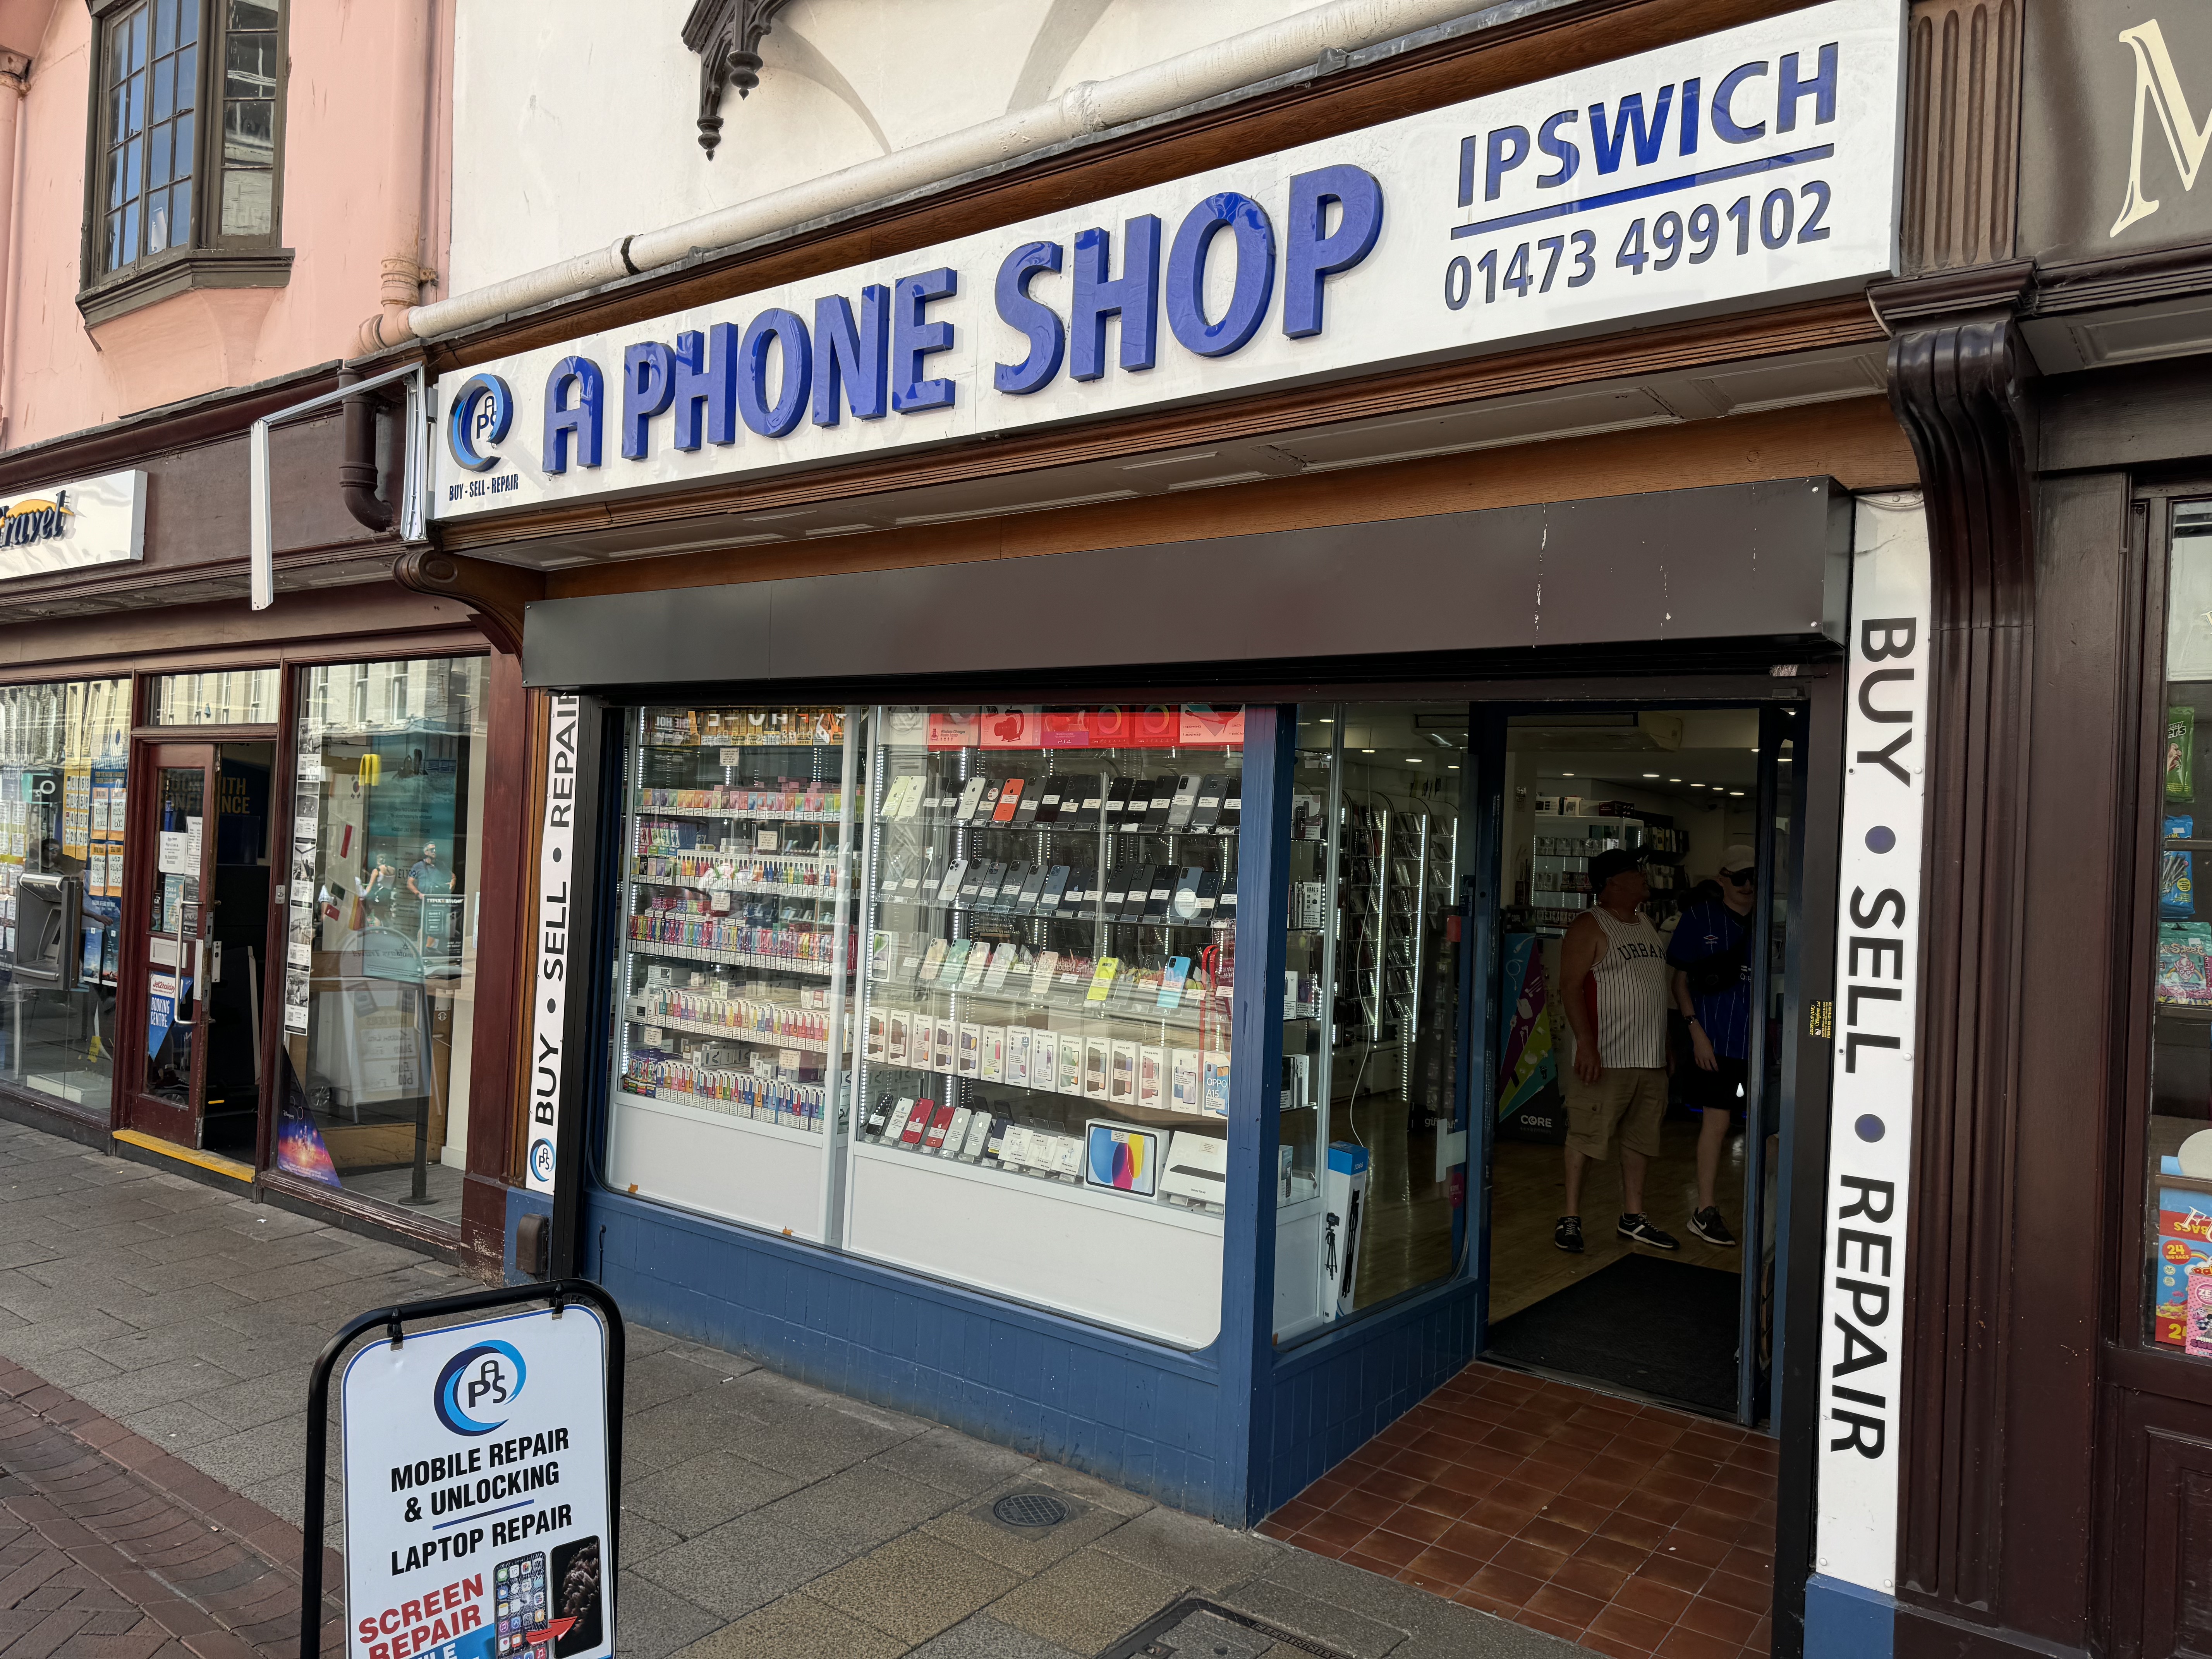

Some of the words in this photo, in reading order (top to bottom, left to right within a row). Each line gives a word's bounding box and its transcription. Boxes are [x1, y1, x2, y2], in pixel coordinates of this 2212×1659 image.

[1458, 41, 1839, 208] IPSWICH
[1445, 229, 1596, 311] 01473
[1616, 180, 1831, 275] 499102
[543, 355, 605, 476] A
[621, 267, 956, 462] PHONE
[993, 164, 1384, 396] SHOP
[449, 483, 464, 501] BUY
[469, 479, 485, 498] SELL
[491, 474, 519, 495] REPAIR
[1856, 617, 1917, 788] BUY
[111, 757, 128, 769] MONEY
[221, 777, 246, 795] ITH
[544, 881, 567, 982] SELL
[1617, 943, 1666, 960] URBAN
[151, 997, 170, 1014] BOOKING
[153, 981, 175, 993] Jet2holiday
[1844, 885, 1906, 1074] SELL
[151, 1012, 168, 1028] CENTRE
[535, 1032, 558, 1126] BUY
[1206, 1089, 1219, 1097] A15
[1207, 1078, 1227, 1088] OPPO
[1520, 1115, 1552, 1128] CORE
[2167, 1244, 2185, 1255] 24
[1830, 1174, 1895, 1460] REPAIR
[391, 1447, 481, 1493] MOBILE
[489, 1427, 569, 1467] REPAIR
[404, 1497, 422, 1523] &
[431, 1461, 560, 1516] UNLOCKING
[391, 1527, 484, 1577] LAPTOP
[492, 1504, 572, 1547] REPAIR
[359, 1572, 484, 1644] SCREEN
[369, 1604, 482, 1659] REPAIR
